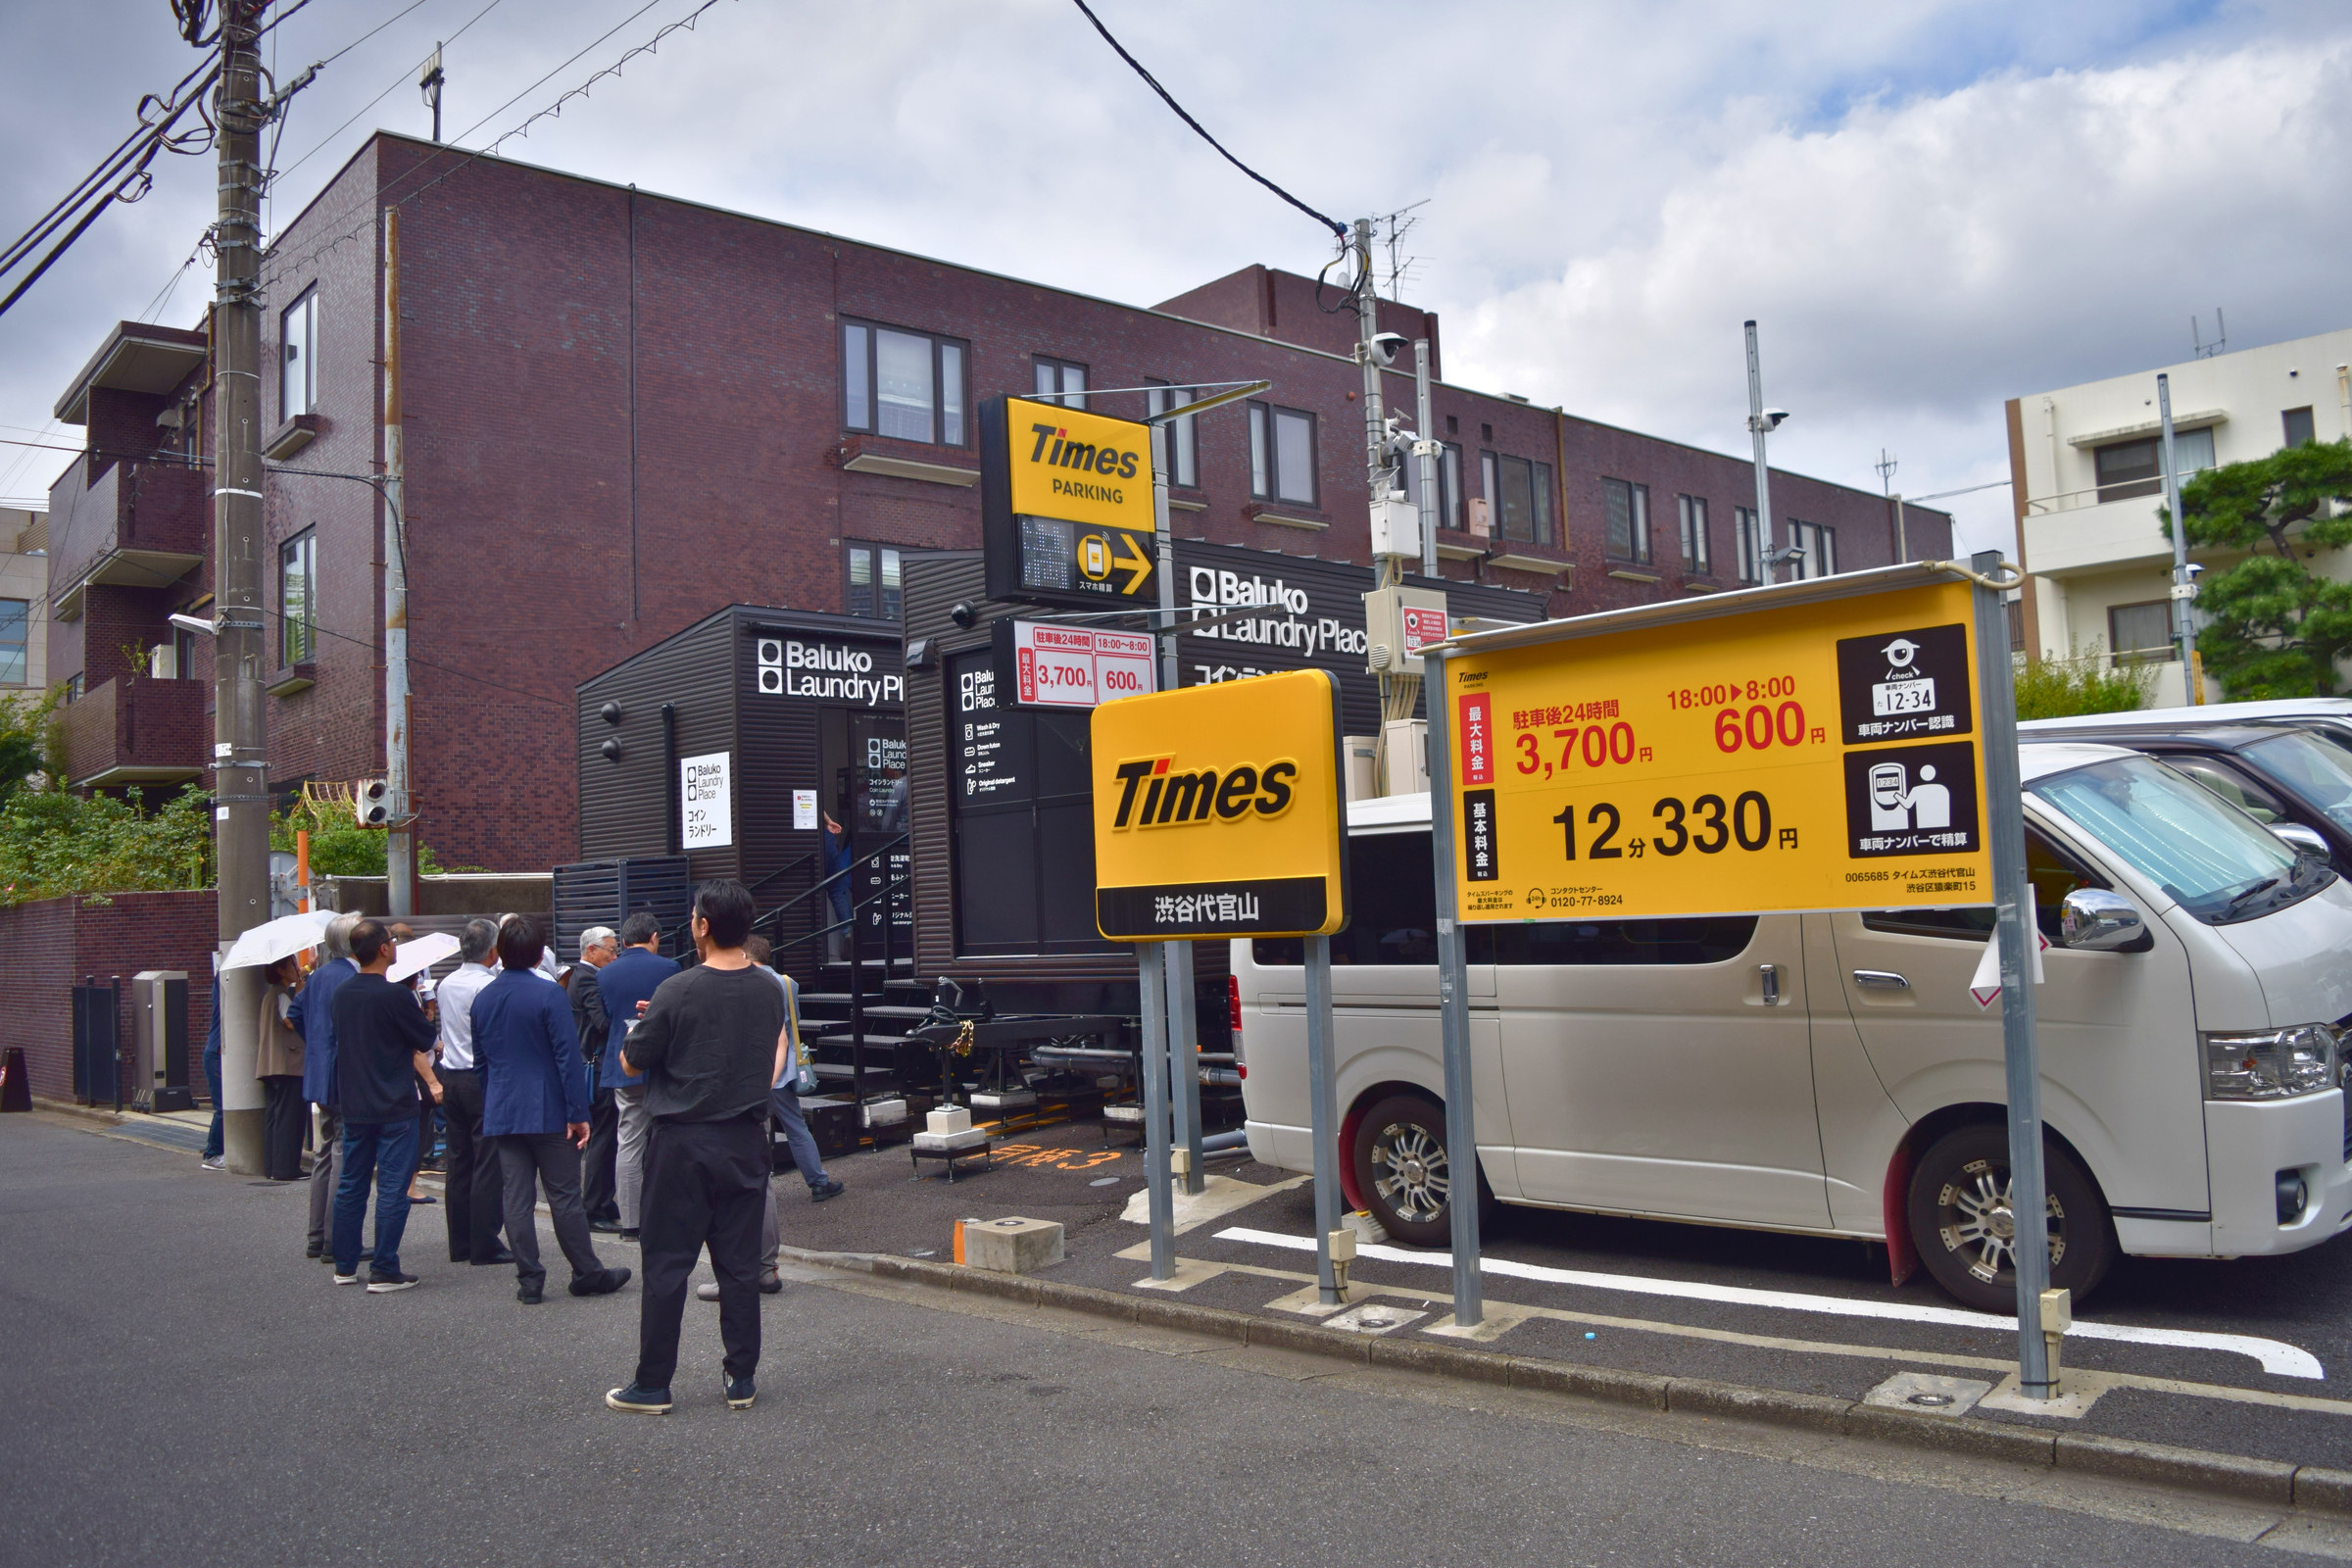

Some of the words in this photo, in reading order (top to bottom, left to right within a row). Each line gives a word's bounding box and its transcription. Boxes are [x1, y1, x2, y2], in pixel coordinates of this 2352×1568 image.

[1030, 422, 1139, 478] Times
[1053, 478, 1123, 504] PARKING
[1079, 581, 1112, 593] スマホ精算
[1219, 570, 1308, 614] Baluko
[1036, 631, 1091, 647] 駐車後24時間
[1221, 608, 1317, 658] Laundry
[1318, 618, 1368, 654] Plac
[786, 641, 872, 672] Baluko
[1021, 653, 1032, 697] 最大料金
[1038, 664, 1093, 689] 3,700円
[1105, 670, 1143, 691] 600円
[1458, 671, 1489, 683] Times
[1891, 671, 1913, 680] check
[787, 668, 881, 707] Laundry
[1667, 684, 1726, 710] 18:00
[1746, 675, 1795, 701] 8:00
[1885, 681, 1922, 691] 車両ナンバー
[1886, 689, 1931, 711] 12-34
[1513, 699, 1619, 730] 駐車後24時間
[1715, 701, 1826, 753] 600円
[1858, 714, 1954, 737] 車両ナンバー認識
[882, 739, 906, 749] Baluk
[1468, 706, 1484, 771] 最大料金
[1516, 721, 1653, 781] 3,700円
[698, 763, 721, 776] Baluko
[883, 759, 906, 769] Place
[698, 775, 724, 789] Laundry
[698, 788, 716, 801] Place
[1114, 759, 1297, 828] Times
[688, 809, 707, 822] コイン
[689, 824, 717, 839] ランドリー
[1473, 802, 1489, 867] 基本料金
[1859, 832, 1967, 851] 車両ナンバーで精算
[1845, 871, 1889, 883] 0065685
[1892, 867, 1976, 881] タイムズ渋谷代官山
[1550, 886, 1603, 895] コンタクトセンター
[1906, 881, 1976, 894] 渋谷区猿楽町15
[1154, 892, 1259, 923] 渋谷代官山
[1550, 895, 1623, 907] 0120-77-8924
